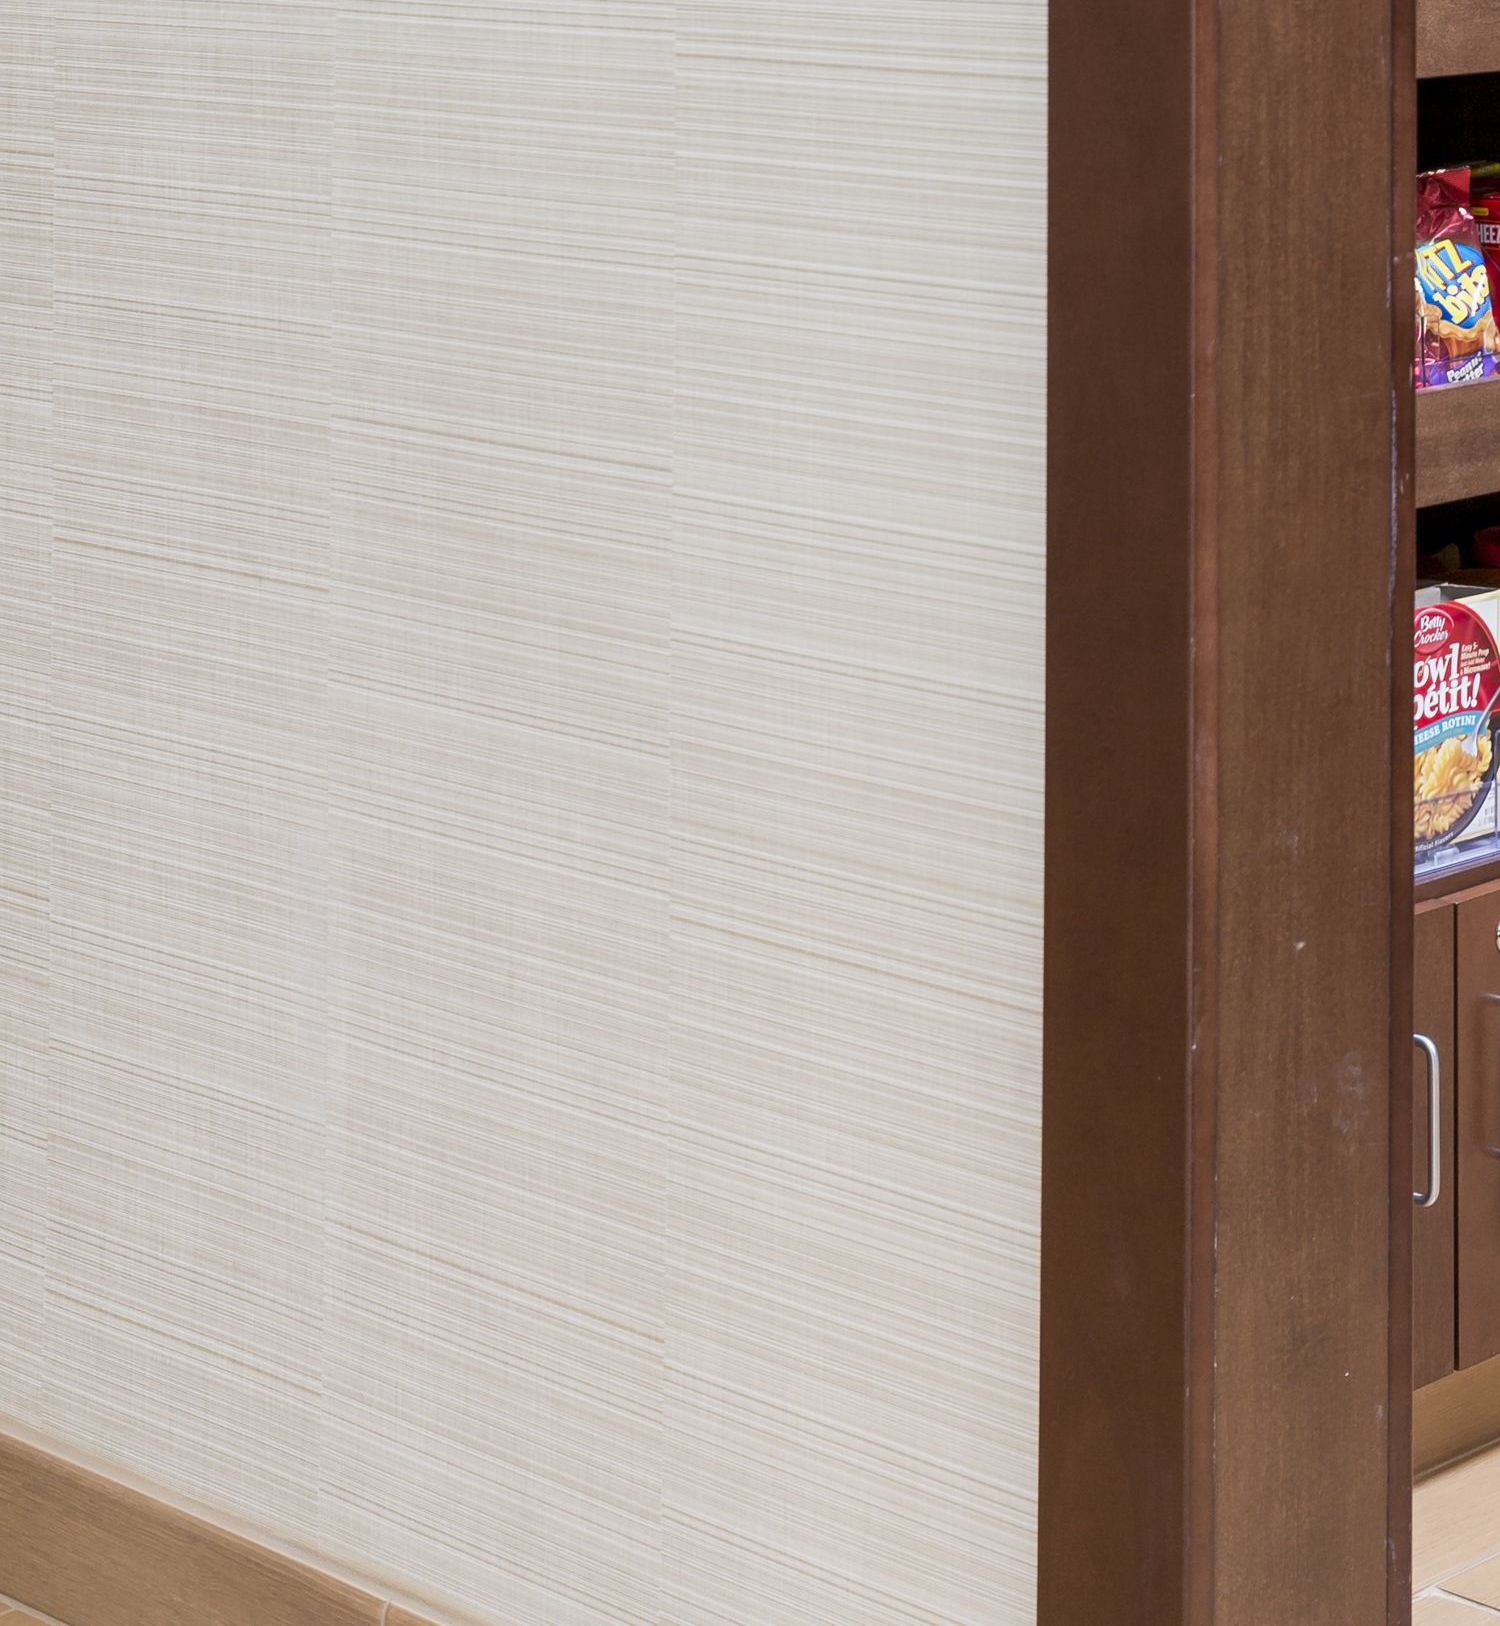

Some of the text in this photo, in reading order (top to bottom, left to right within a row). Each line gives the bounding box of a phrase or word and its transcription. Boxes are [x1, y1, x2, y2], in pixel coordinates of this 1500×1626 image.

[1416, 239, 1474, 292] ITZ
[1420, 614, 1446, 632] Betty
[1414, 627, 1449, 649] Crocker
[1414, 642, 1460, 684] owl
[1442, 715, 1476, 733] ROTINI
